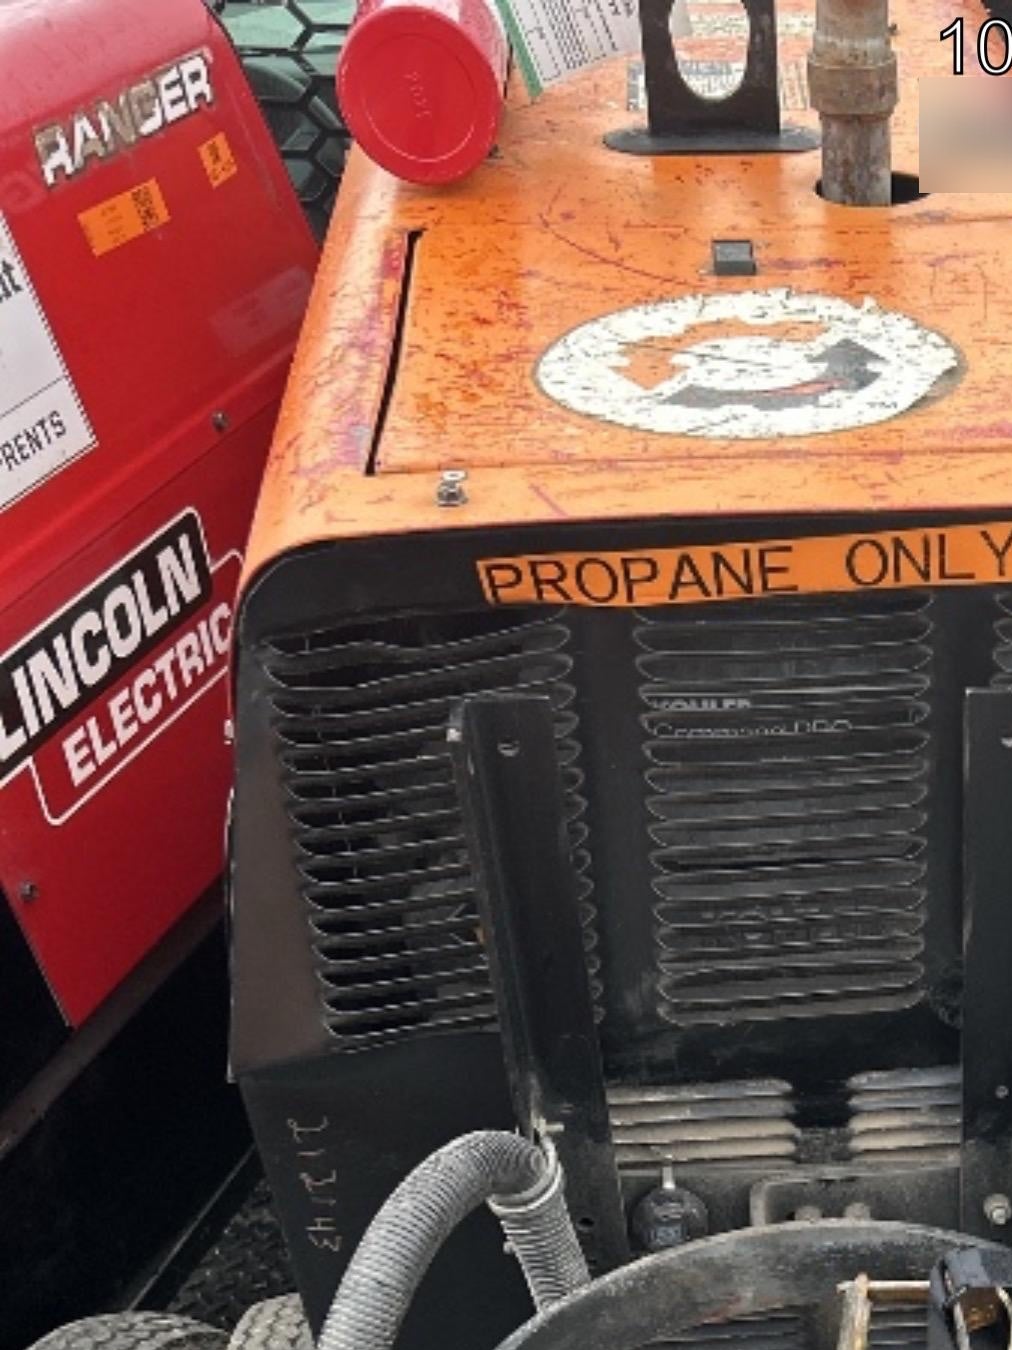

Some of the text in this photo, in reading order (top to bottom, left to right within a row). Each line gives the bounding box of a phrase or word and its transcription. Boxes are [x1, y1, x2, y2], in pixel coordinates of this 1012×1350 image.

[33, 54, 214, 187] RANGER
[484, 545, 799, 604] PROPANE
[61, 602, 232, 788] ELECTRIC
